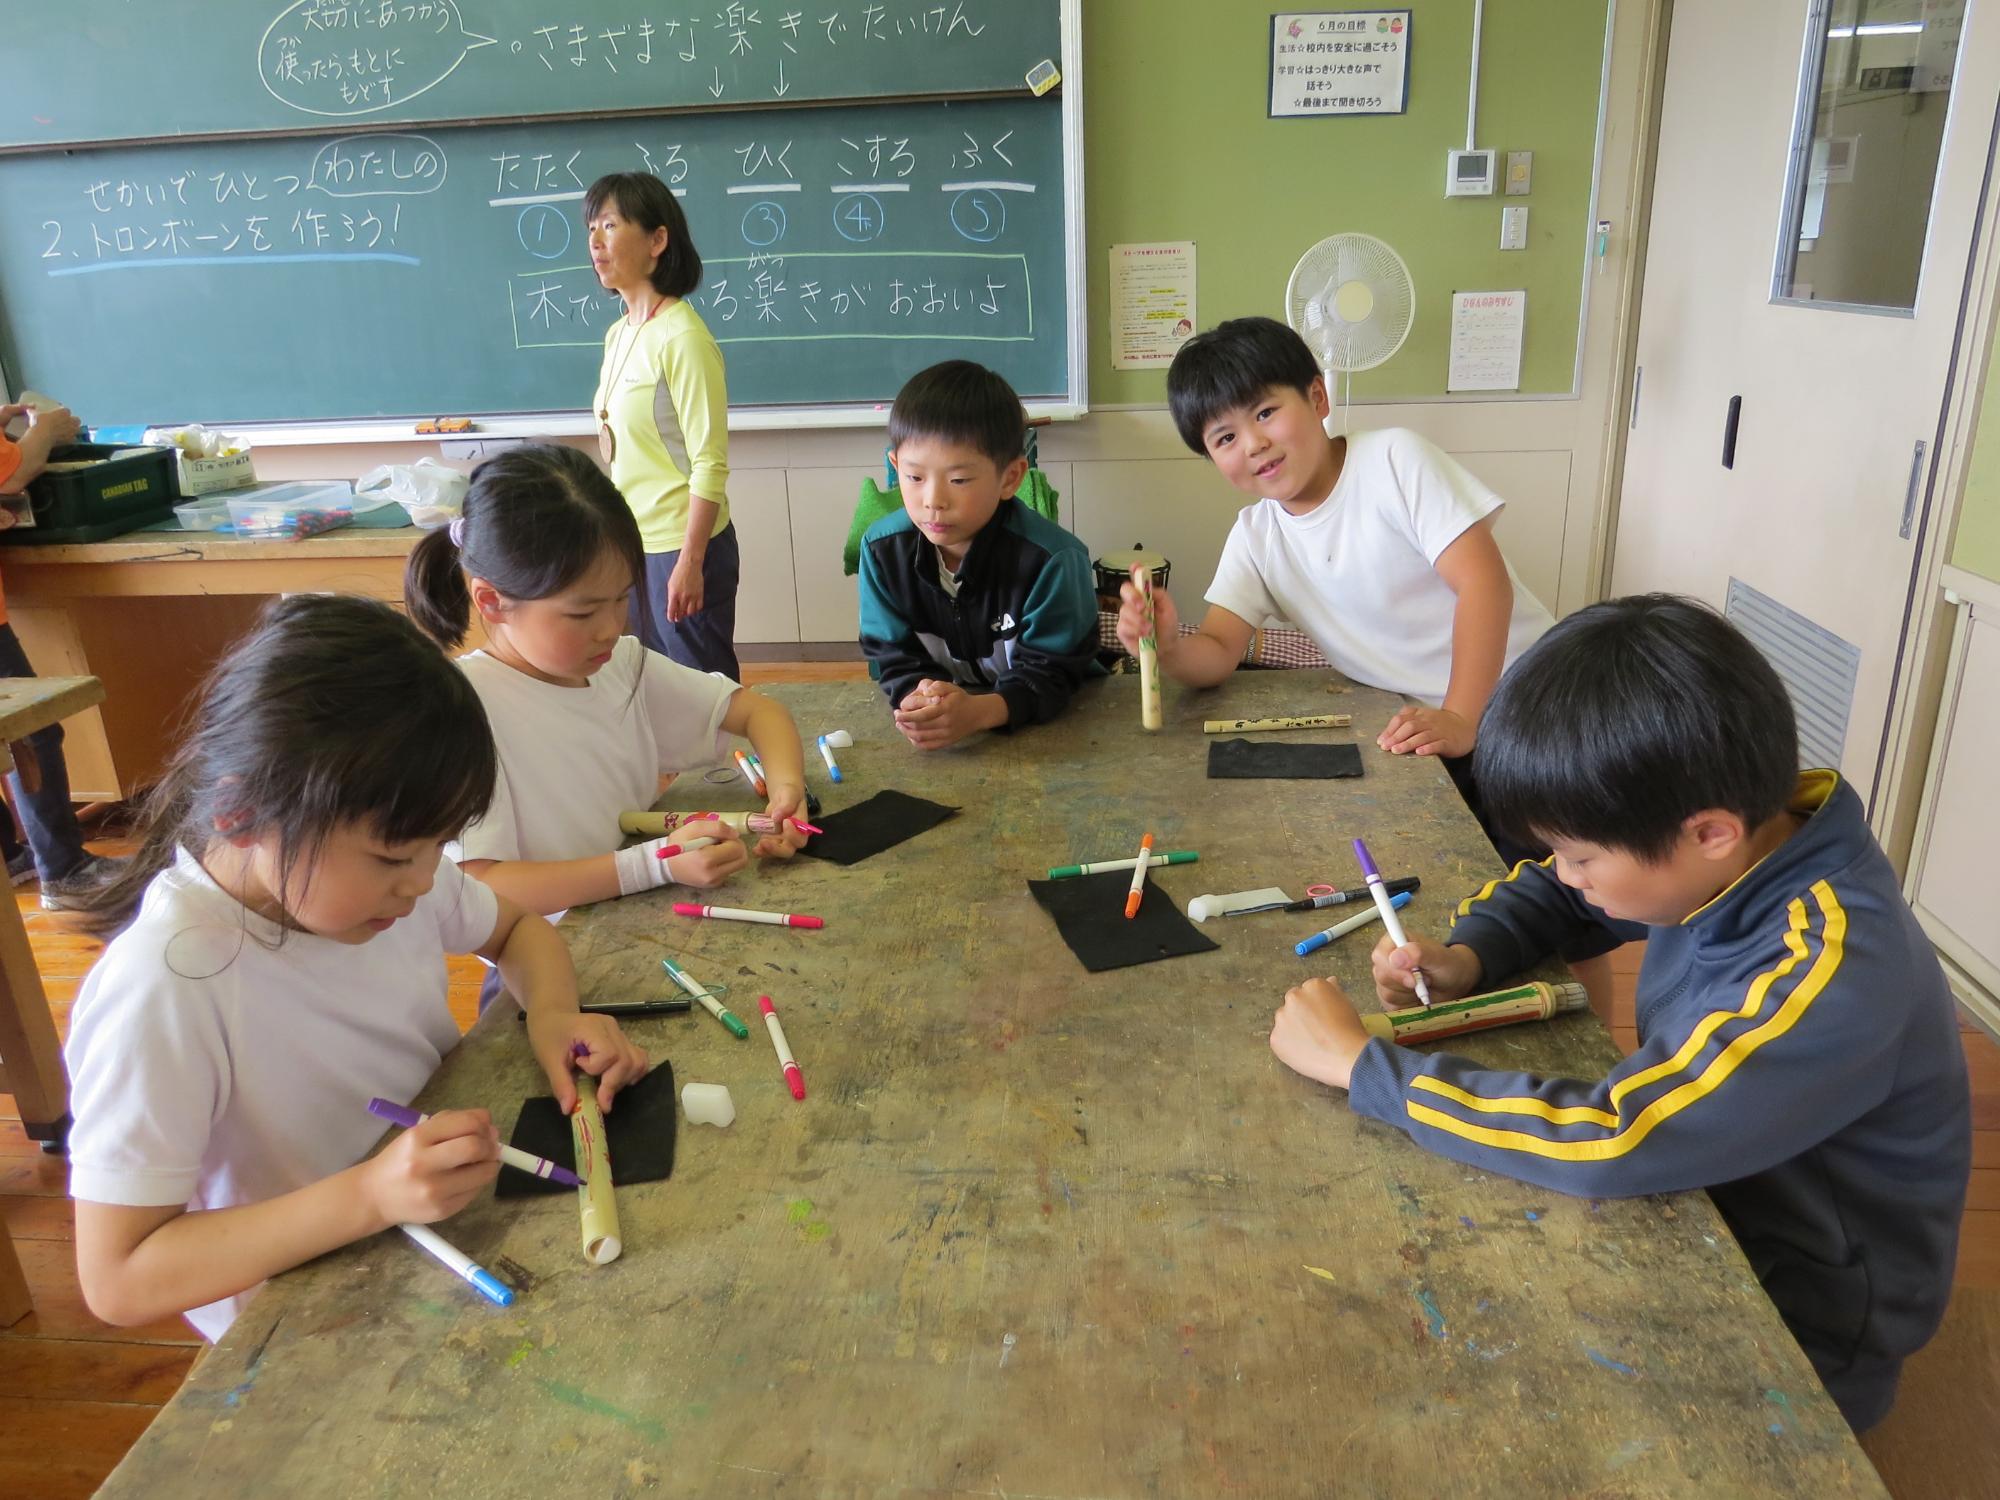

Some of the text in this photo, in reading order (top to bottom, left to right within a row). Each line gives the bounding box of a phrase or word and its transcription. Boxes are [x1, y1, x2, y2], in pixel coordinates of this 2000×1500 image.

[1318, 20, 1367, 32] 6月の目標
[340, 75, 395, 105] もどす
[1306, 81, 1333, 92] 話そう
[324, 146, 438, 184] わたしの
[734, 140, 793, 179] ひく
[837, 135, 916, 178] こする
[951, 130, 1014, 169] ふく
[490, 150, 584, 193] たたく
